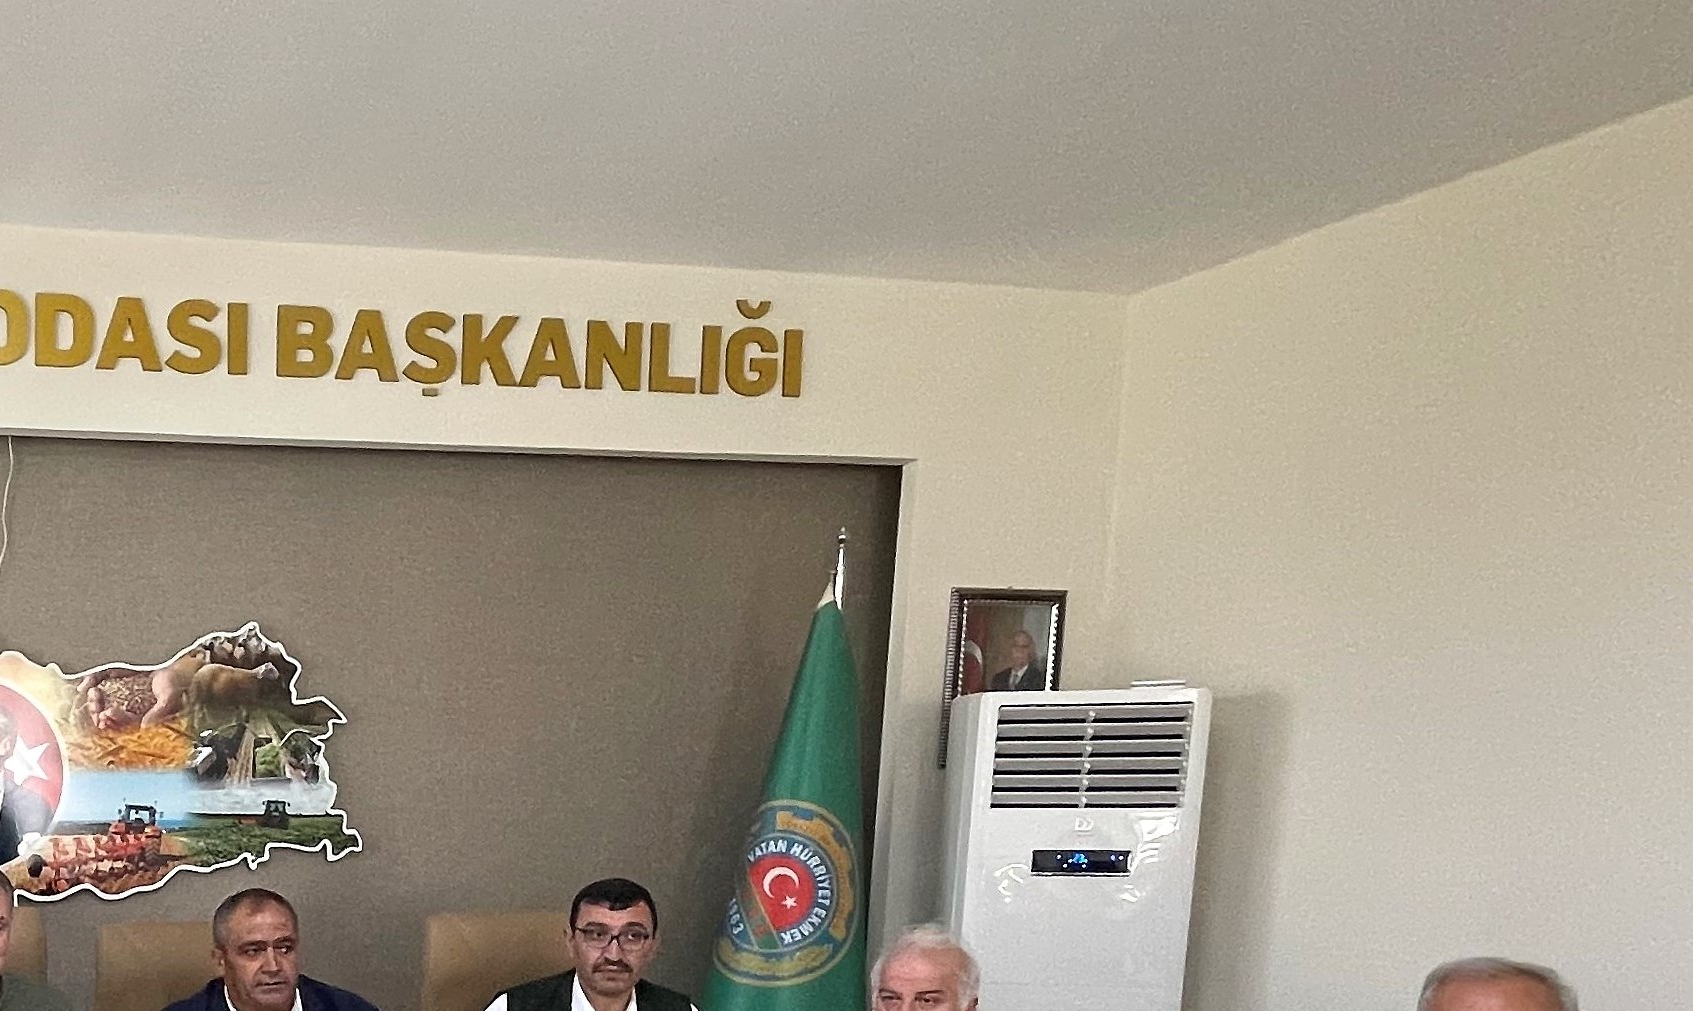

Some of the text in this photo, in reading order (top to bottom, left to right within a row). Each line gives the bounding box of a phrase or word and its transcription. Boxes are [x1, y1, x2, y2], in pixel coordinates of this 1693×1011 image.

[276, 298, 804, 398] BAŞKANLIĞI
[747, 839, 787, 863] VATAN
[780, 907, 827, 944] EKMEK
